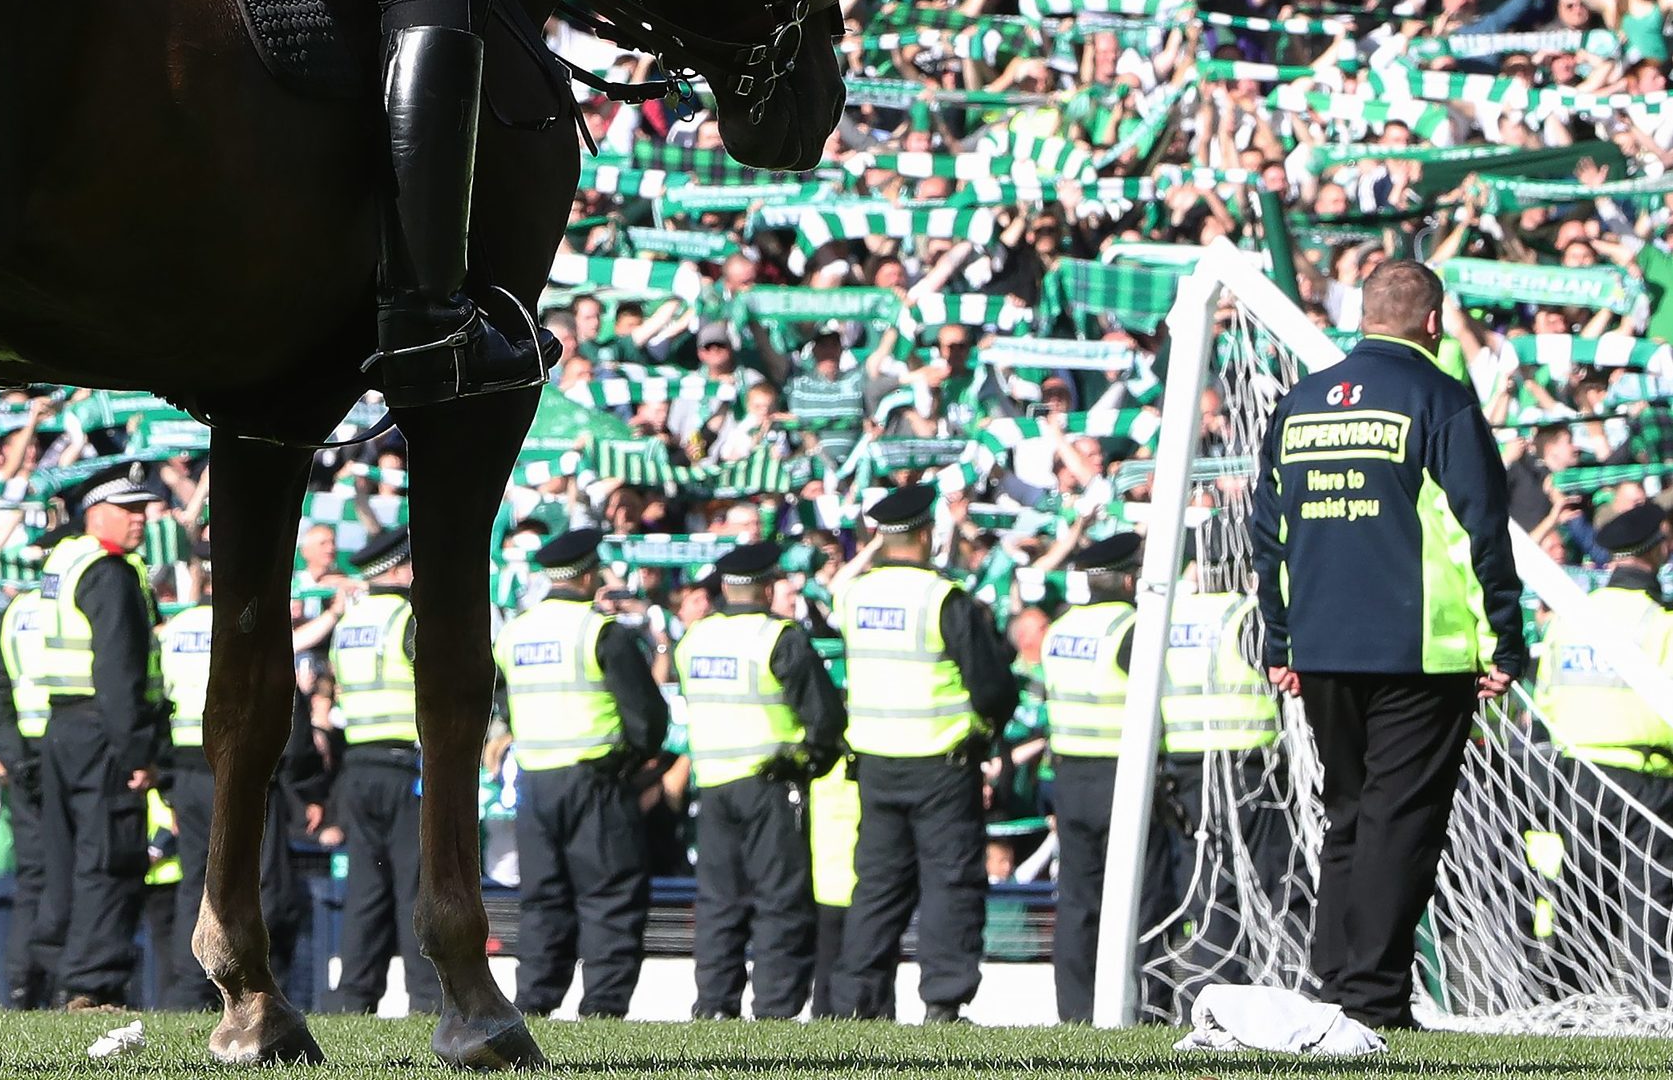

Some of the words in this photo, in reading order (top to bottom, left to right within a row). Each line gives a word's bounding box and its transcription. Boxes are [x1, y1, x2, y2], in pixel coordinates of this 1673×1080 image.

[1326, 382, 1363, 406] G4S
[1285, 422, 1399, 450] SUPERVISOR
[1307, 470, 1345, 491] Here
[1347, 468, 1365, 488] to
[1301, 497, 1346, 519] assist
[1348, 499, 1379, 521] you
[857, 607, 905, 629] POLICE
[337, 627, 377, 648] POLICE
[1049, 636, 1097, 660] POLICE
[515, 642, 560, 665] POLICE
[690, 656, 736, 679] POLICE
